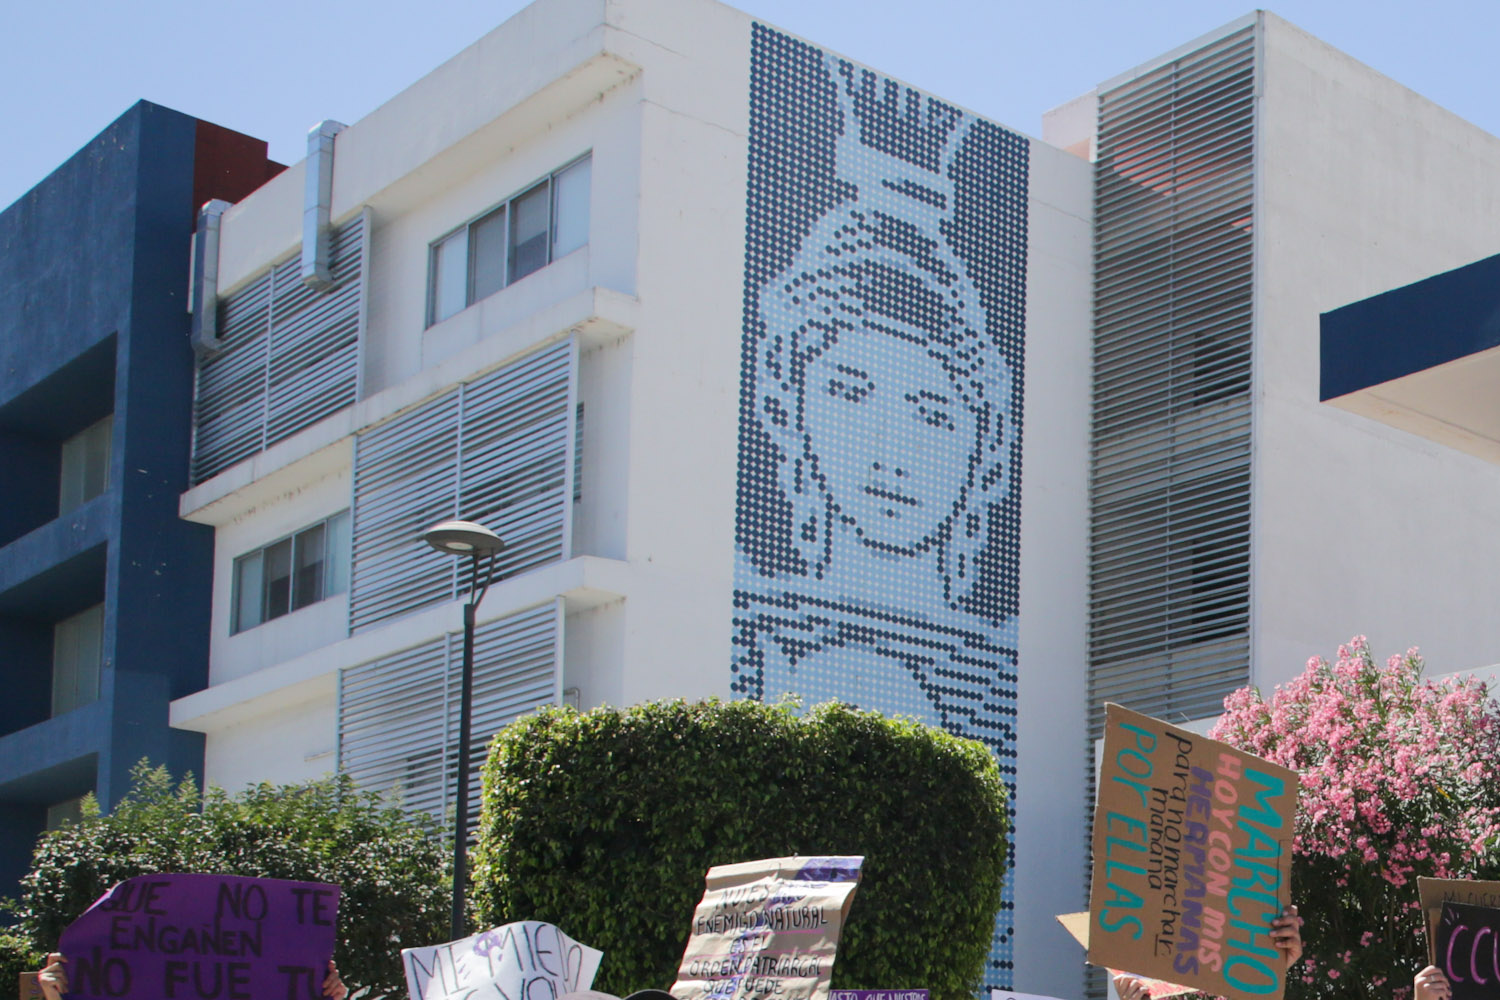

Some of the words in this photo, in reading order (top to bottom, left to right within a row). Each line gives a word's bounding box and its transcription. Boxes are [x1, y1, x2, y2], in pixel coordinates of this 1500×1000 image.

[1165, 731, 1193, 800] para
[1211, 752, 1243, 831] HOY
[1098, 811, 1149, 941] ELLAS
[1172, 765, 1215, 977] HERMANAS
[1206, 829, 1233, 898] CON
[1222, 767, 1286, 996] MARCHO
[110, 915, 262, 957] ENGAÑEN
[217, 881, 268, 921] NO
[290, 887, 334, 927] TE
[762, 905, 828, 931] NATURAL
[74, 946, 131, 997] NO
[164, 960, 252, 1000] FUE
[689, 958, 743, 979] ORDEN
[1197, 905, 1226, 973] MIS
